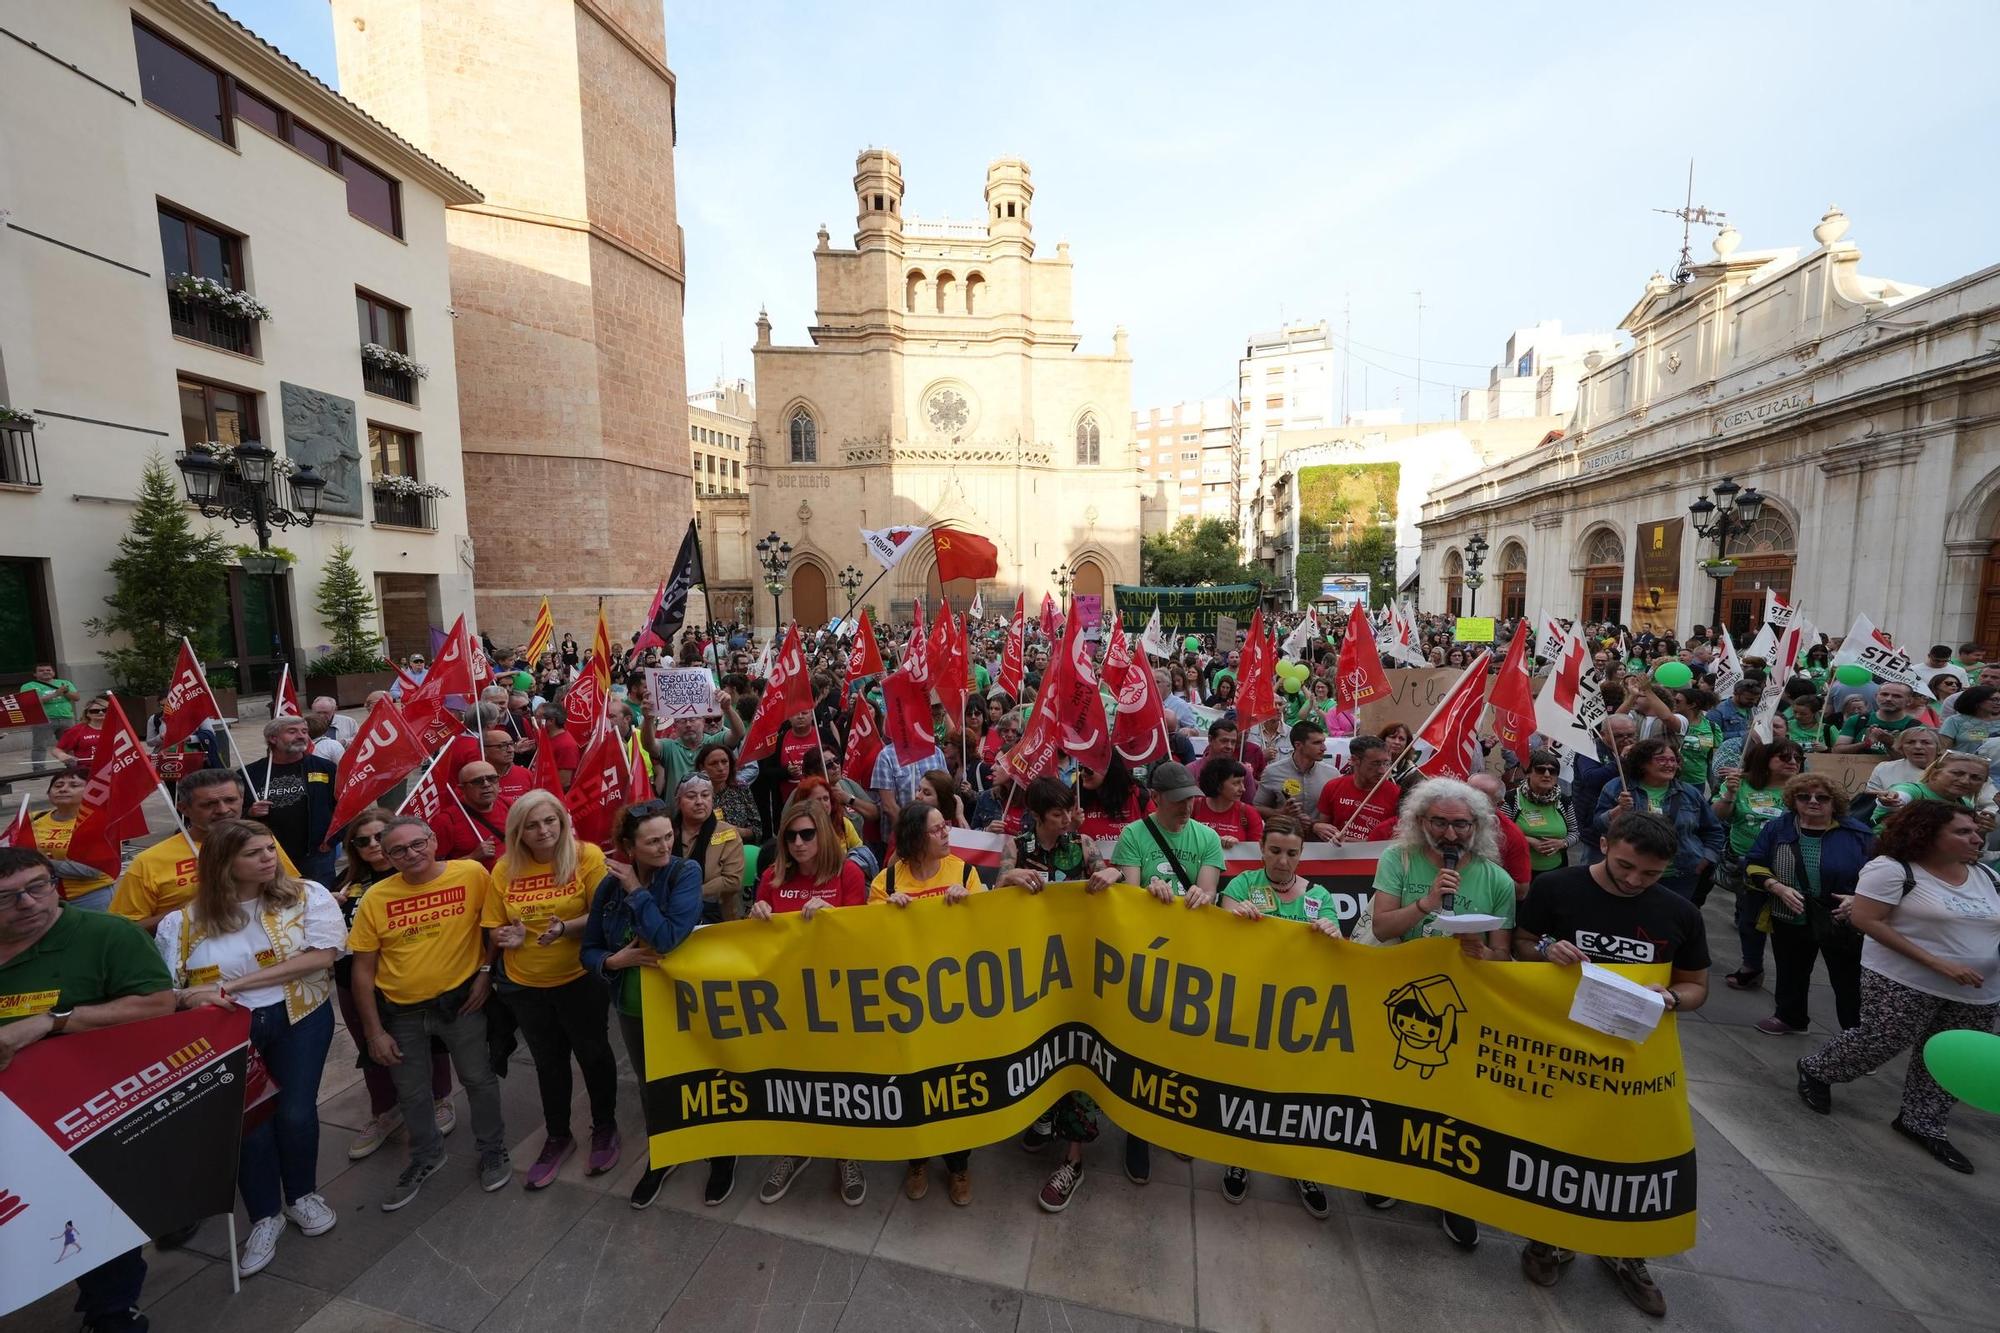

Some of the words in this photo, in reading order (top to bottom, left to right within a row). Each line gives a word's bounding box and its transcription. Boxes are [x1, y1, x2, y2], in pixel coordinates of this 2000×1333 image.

[1723, 394, 1802, 428] CENTRAL
[1120, 591, 1158, 607] VENIM
[1169, 591, 1184, 607] DE
[1185, 612, 1197, 628] DE
[1087, 811, 1102, 819] UGT
[1339, 797, 1355, 806] UGT
[508, 885, 577, 904] educació
[780, 889, 800, 899] UGT
[388, 903, 466, 930] educació
[520, 905, 535, 915] 23M
[675, 979, 787, 1040] PER
[801, 934, 1073, 1034] L'ESCOLA
[1093, 936, 1355, 1053] PÚBLICA
[1480, 1024, 1625, 1074] PLATAFORMA
[1476, 1062, 1554, 1099] PÚBLIC
[1478, 1044, 1517, 1069] PER
[1527, 1059, 1677, 1096] L'ENSENYAMENT
[54, 1060, 171, 1136] CCOO
[67, 1101, 128, 1142] federació
[130, 1049, 217, 1103] d'ensenyament
[681, 1070, 748, 1121] MÉS
[765, 1076, 903, 1121] INVERSIÓ
[922, 1064, 990, 1116] MÉS
[1006, 1030, 1117, 1097] QUALITAT
[1131, 1065, 1200, 1119] MÉS
[1218, 1098, 1378, 1150] VALENCIÀ
[1400, 1117, 1482, 1175] MÉS
[1506, 1149, 1678, 1213] DIGNITAT
